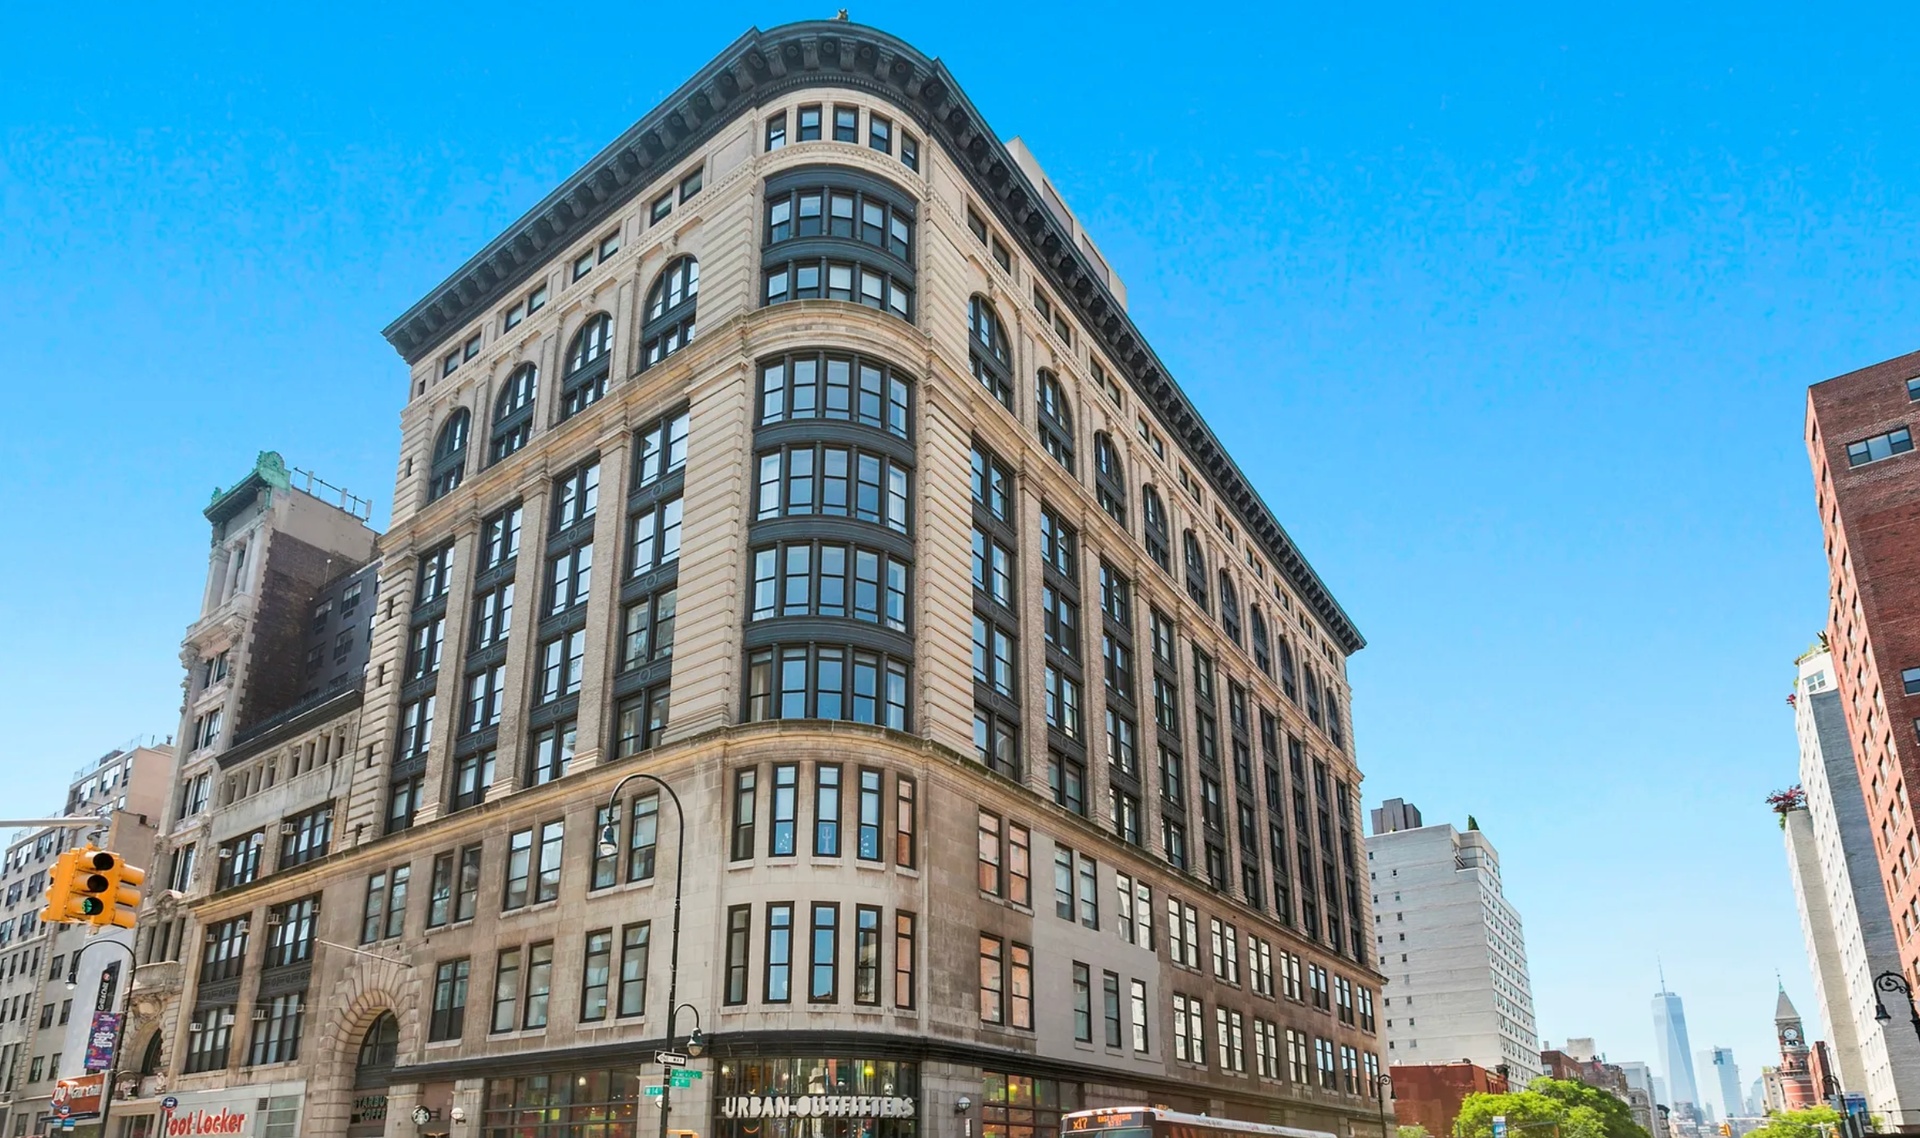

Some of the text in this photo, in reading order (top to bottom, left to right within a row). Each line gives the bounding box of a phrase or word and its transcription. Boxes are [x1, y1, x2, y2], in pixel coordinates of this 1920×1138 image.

[353, 1095, 386, 1109] STARBU
[725, 1095, 915, 1119] URBAN OUTFITTERS
[196, 1107, 245, 1134] Locker
[360, 1108, 386, 1121] COFFE
